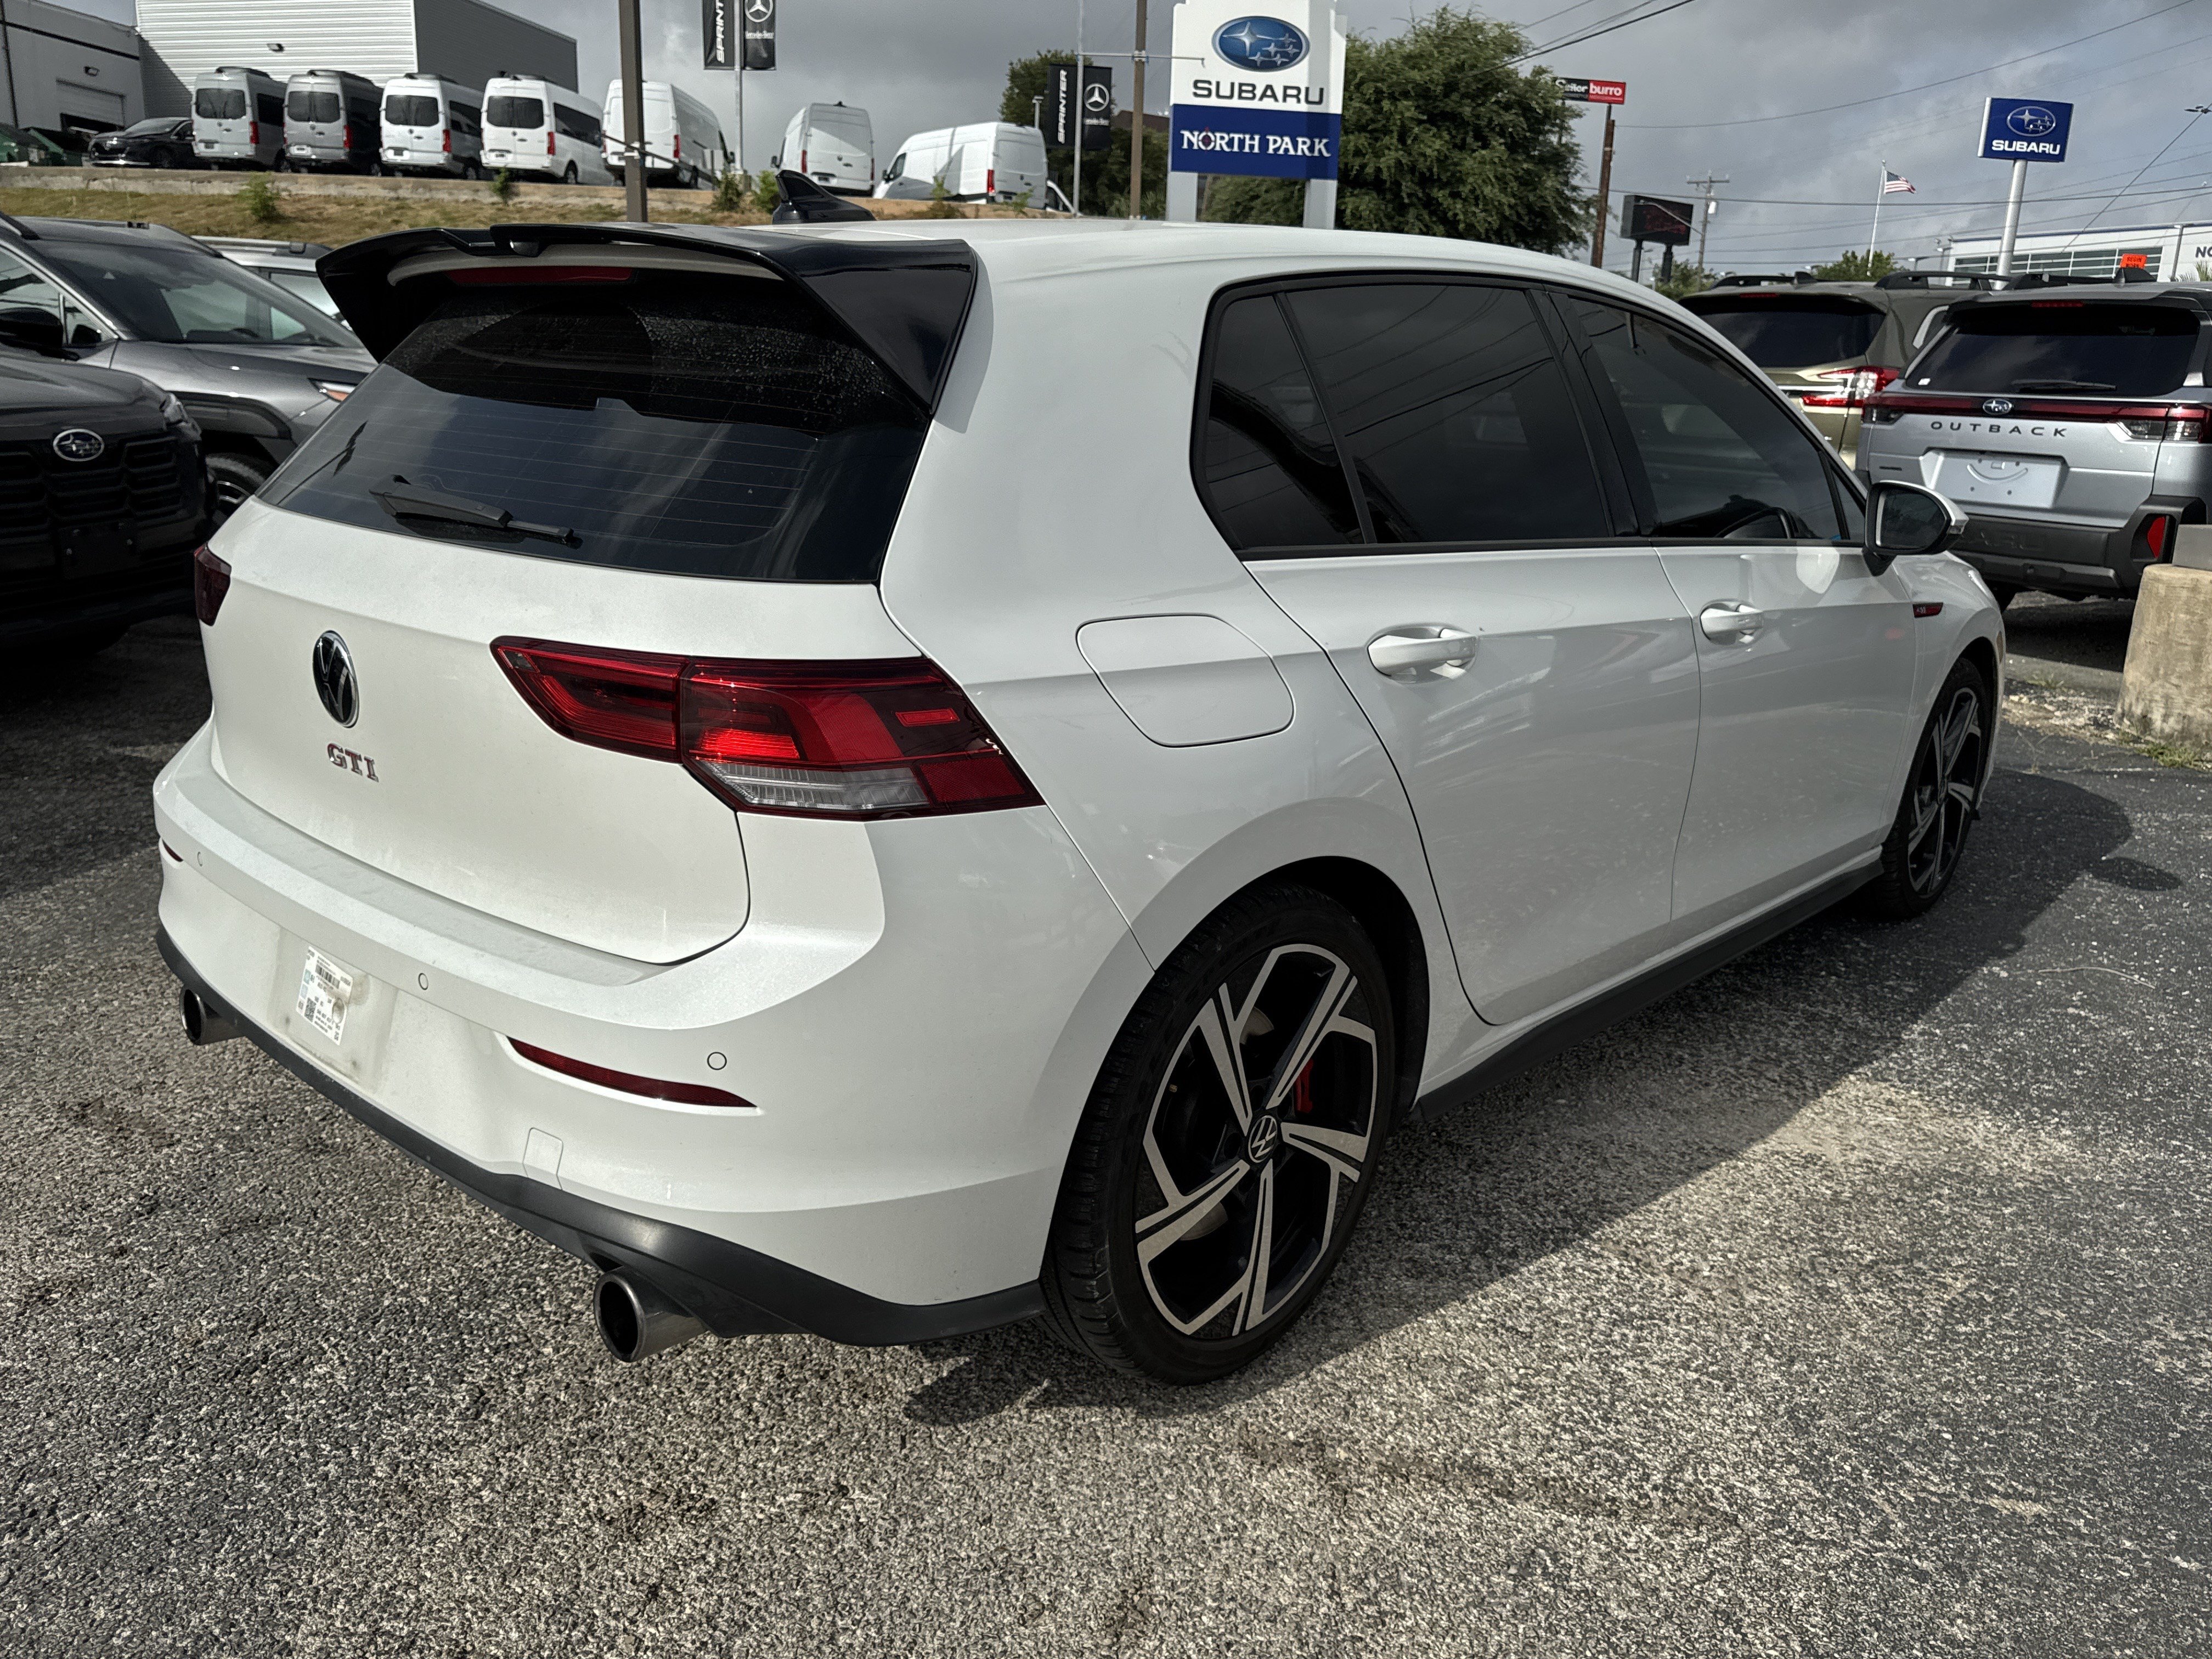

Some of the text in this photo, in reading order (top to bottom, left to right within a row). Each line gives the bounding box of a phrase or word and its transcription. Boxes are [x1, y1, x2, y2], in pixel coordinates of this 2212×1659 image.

[1192, 79, 1324, 105] SUBARU
[1589, 82, 1623, 96] burro
[1057, 69, 1067, 144] SPRINTER
[1180, 128, 1331, 157] NORTH PARK
[1991, 139, 2061, 155] SUBARU
[1930, 421, 2067, 438] OUTBACK
[327, 743, 380, 783] GTI
